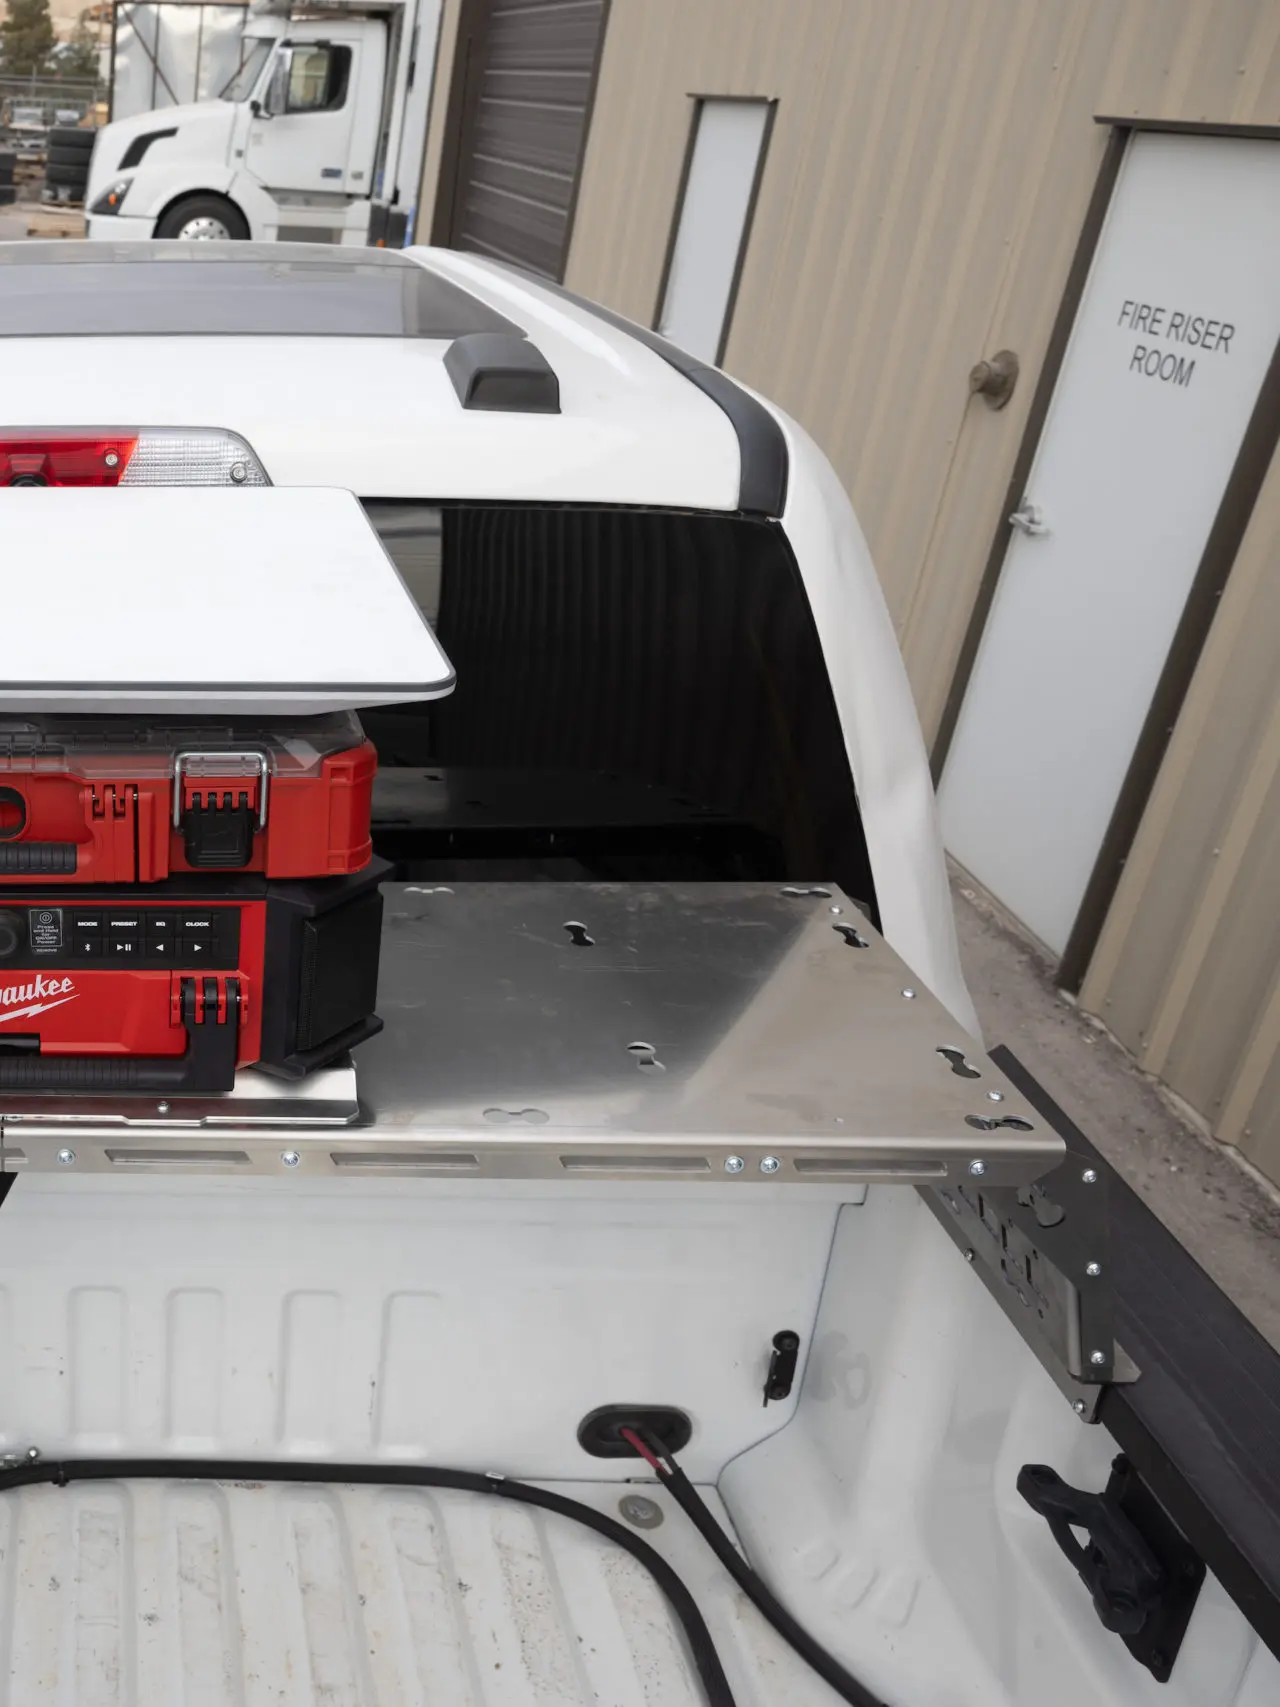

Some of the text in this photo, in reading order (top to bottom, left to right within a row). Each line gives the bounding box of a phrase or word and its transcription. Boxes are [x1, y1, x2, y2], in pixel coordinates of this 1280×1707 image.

[1117, 300, 1235, 354] FIRE RISER
[1129, 344, 1196, 388] ROOM
